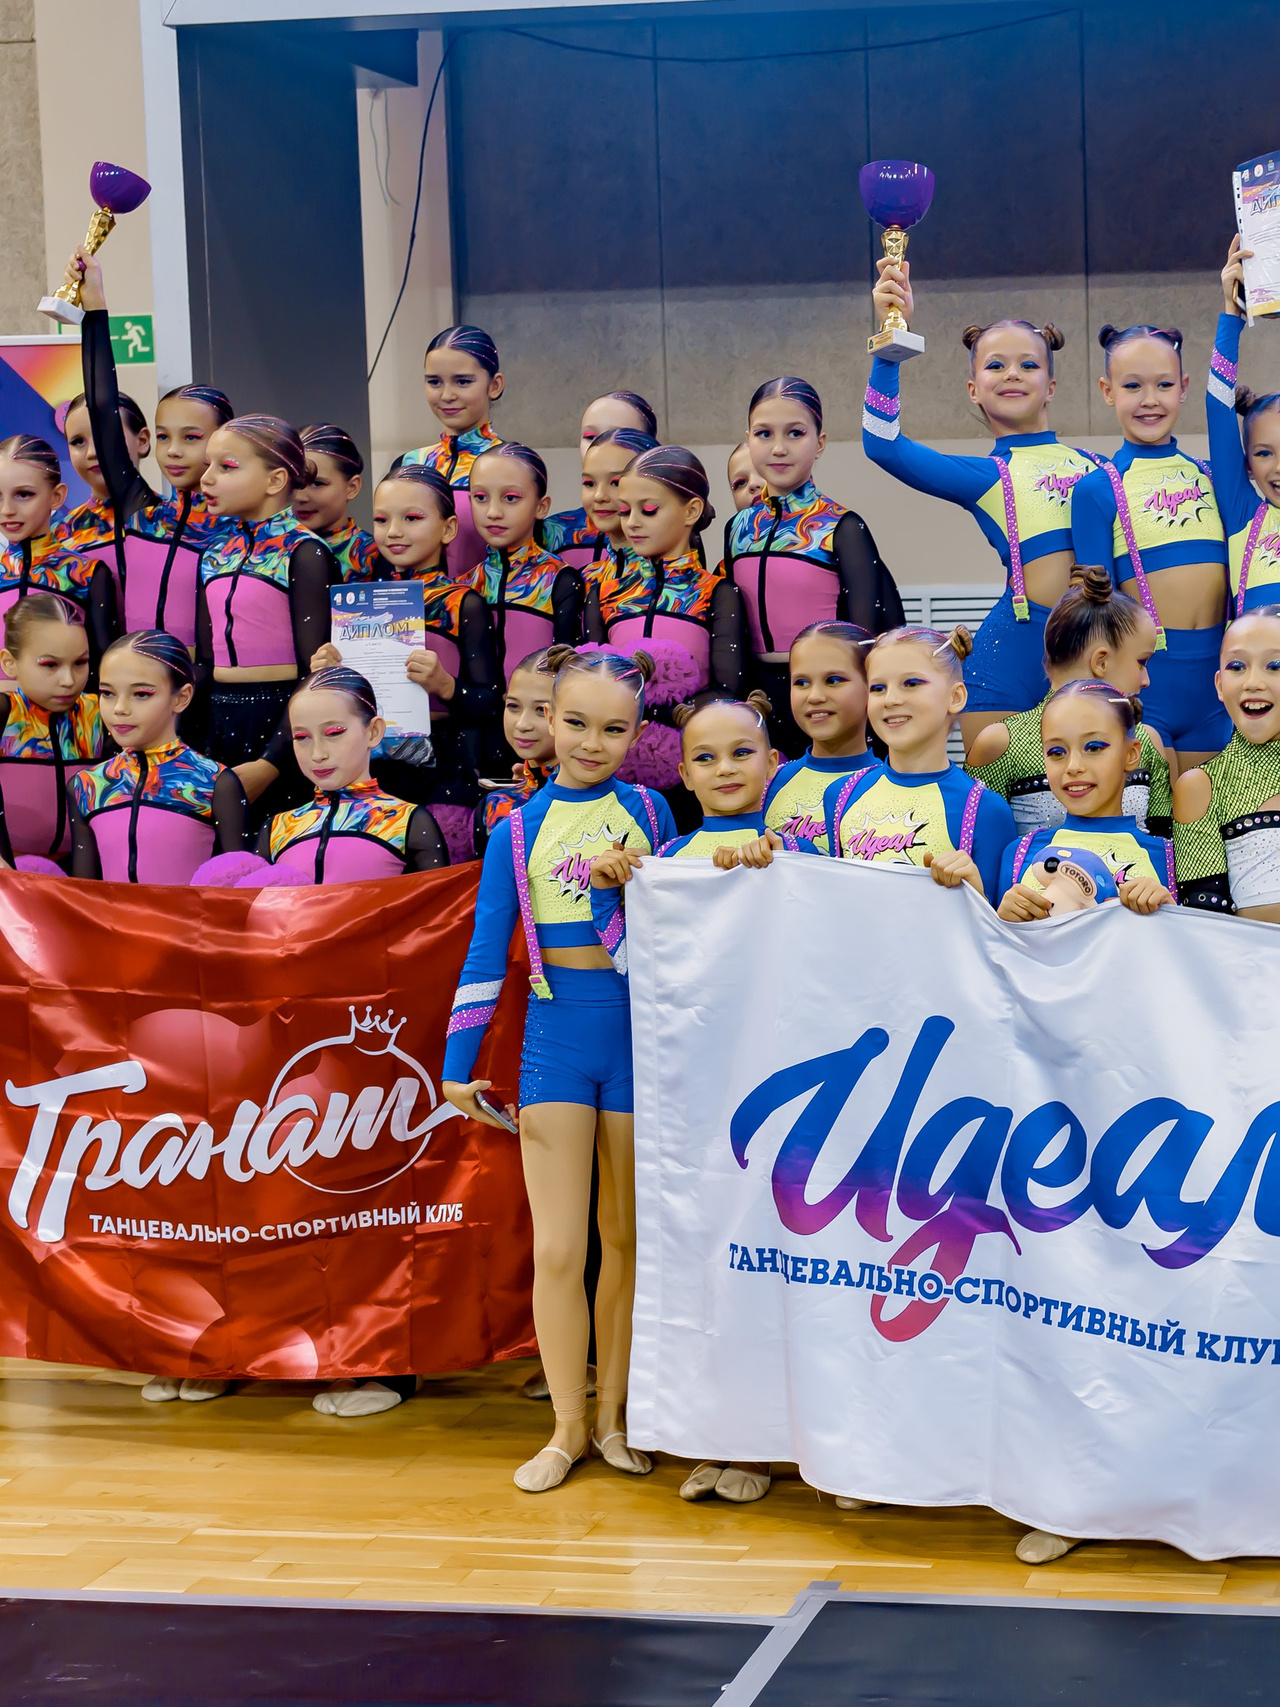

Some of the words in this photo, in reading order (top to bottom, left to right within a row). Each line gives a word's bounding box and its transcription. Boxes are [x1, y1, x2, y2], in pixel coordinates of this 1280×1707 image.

[1144, 486, 1205, 516] Идеал
[340, 622, 410, 641] ДИПЛОМ
[847, 828, 916, 861] Идеал
[1064, 866, 1092, 894] TOTORO
[5, 1060, 470, 1243] Гранат
[89, 1201, 422, 1244] ТАНЦЕВАЛЬНО-СПОРТИВНЫЙ
[425, 1202, 464, 1224] КЛУБ
[728, 1242, 1186, 1356] ТАНЦЕВАЛЬНО-СПОРТИВНЫЙ
